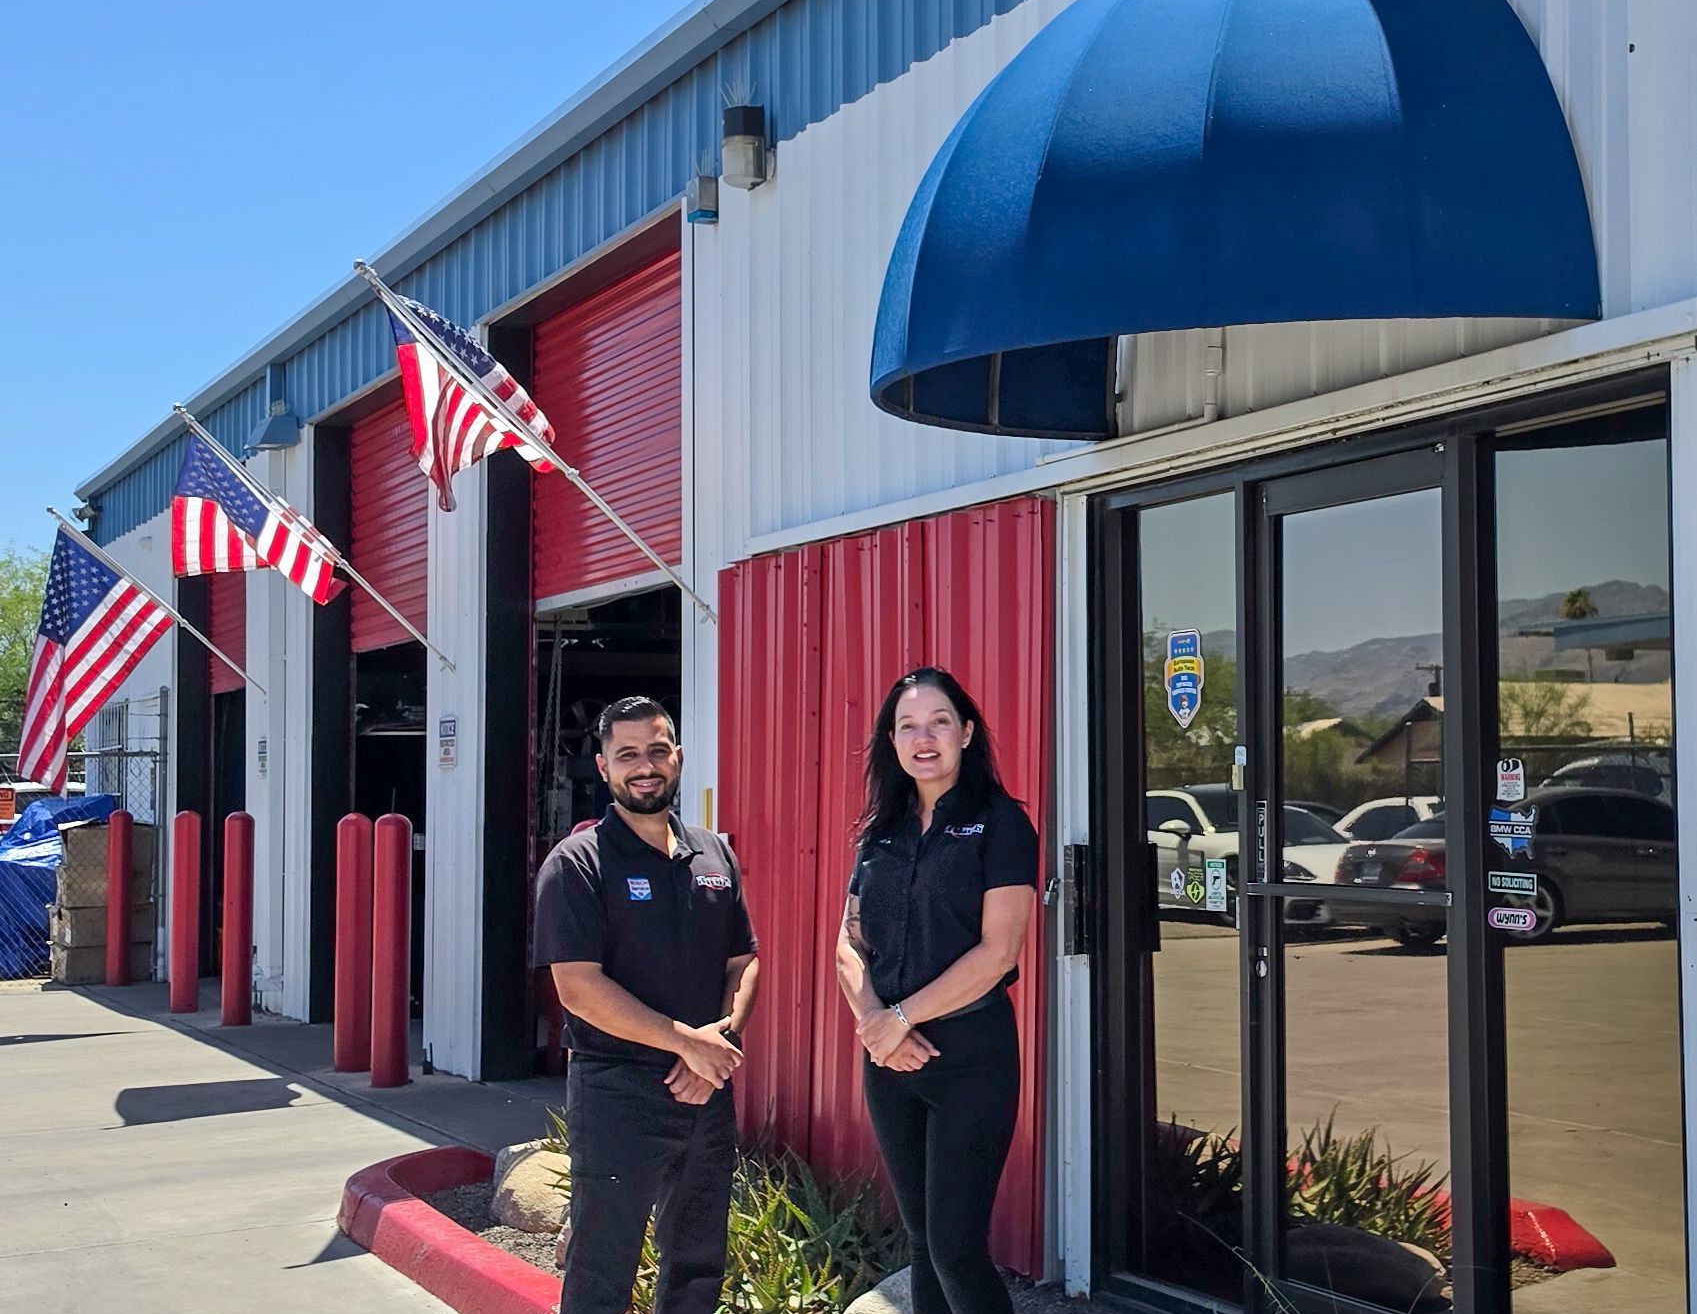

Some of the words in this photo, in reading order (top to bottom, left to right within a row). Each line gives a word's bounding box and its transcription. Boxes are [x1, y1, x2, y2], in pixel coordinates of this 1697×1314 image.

[1490, 825, 1512, 834] BMW
[1513, 825, 1532, 835] CCA
[1492, 876, 1501, 887] NO
[1501, 876, 1533, 890] SOLICITING
